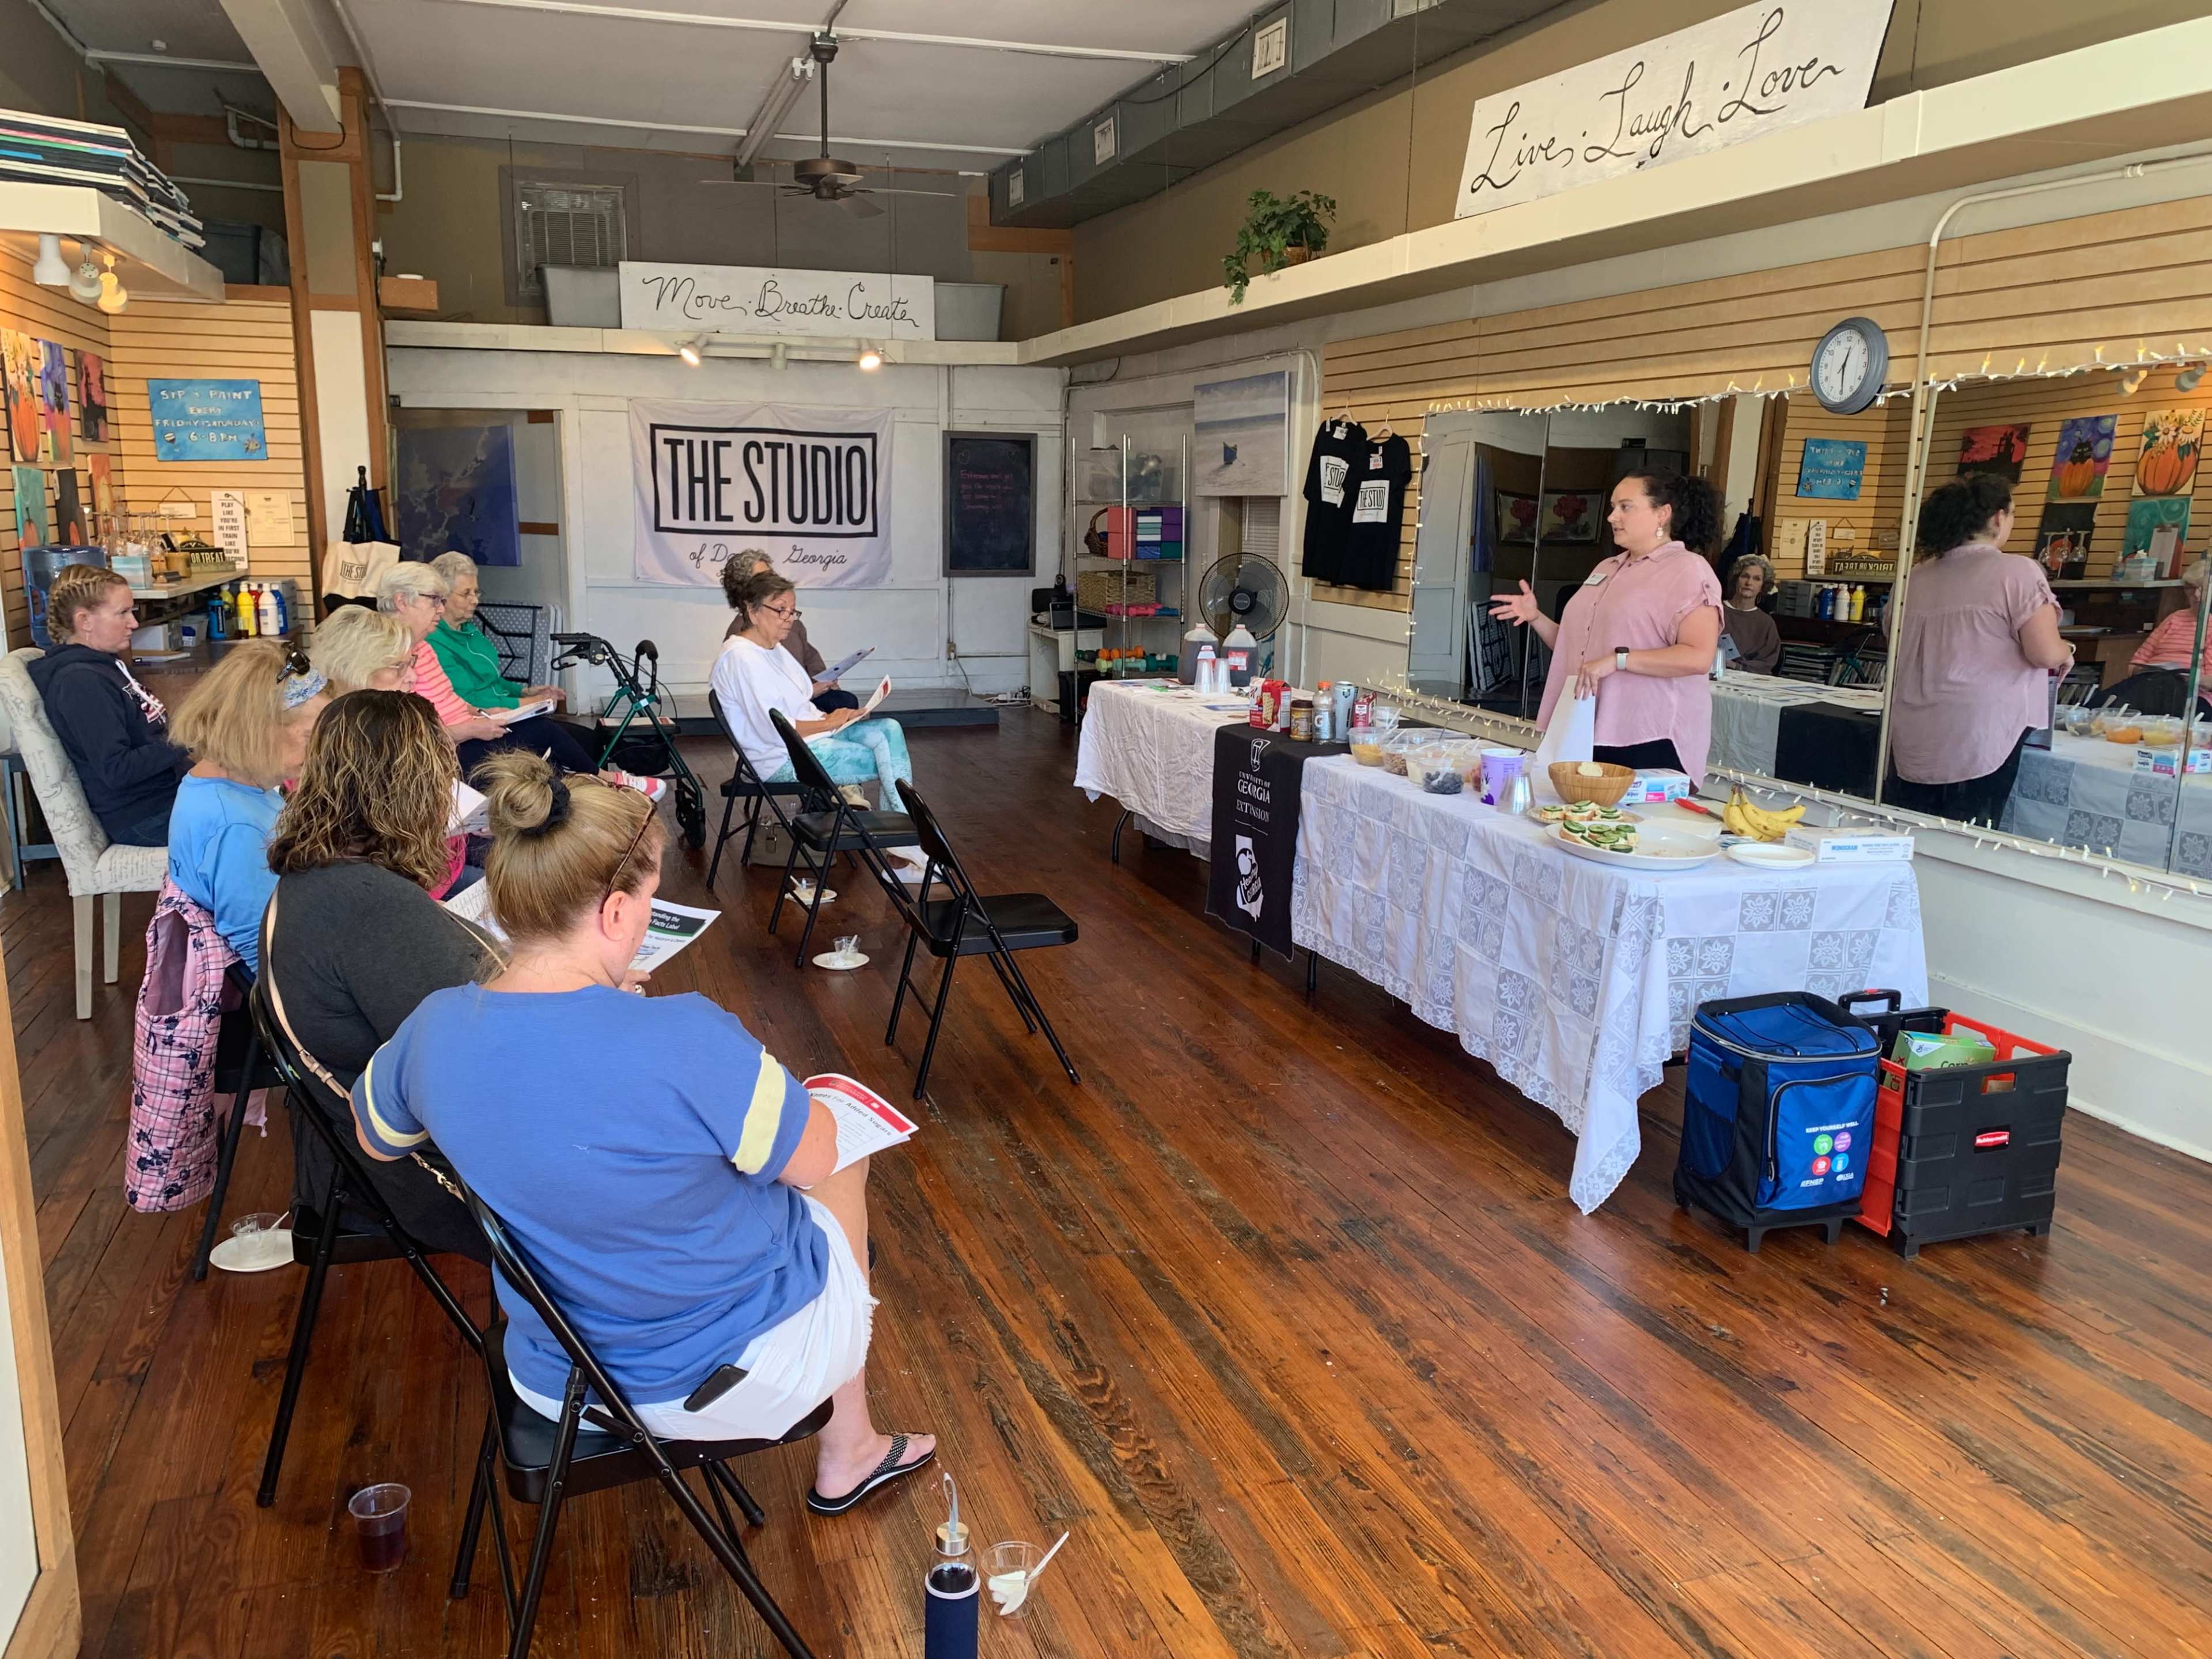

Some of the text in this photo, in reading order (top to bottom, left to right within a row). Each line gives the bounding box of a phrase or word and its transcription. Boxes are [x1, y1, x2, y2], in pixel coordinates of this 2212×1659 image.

[1470, 7, 1846, 194] Live Laugh Love
[642, 276, 919, 327] Move Breathe Create
[160, 389, 185, 400] SIP
[209, 390, 252, 400] PAINT
[663, 438, 867, 526] THE STUDIO
[191, 551, 224, 563] OR TREAT
[689, 543, 707, 569] of
[782, 544, 847, 572] Georgia
[1237, 779, 1271, 804] GEORGIA
[652, 919, 681, 930] Facts Label
[844, 1102, 869, 1118] Added
[869, 1116, 892, 1137] Sugars
